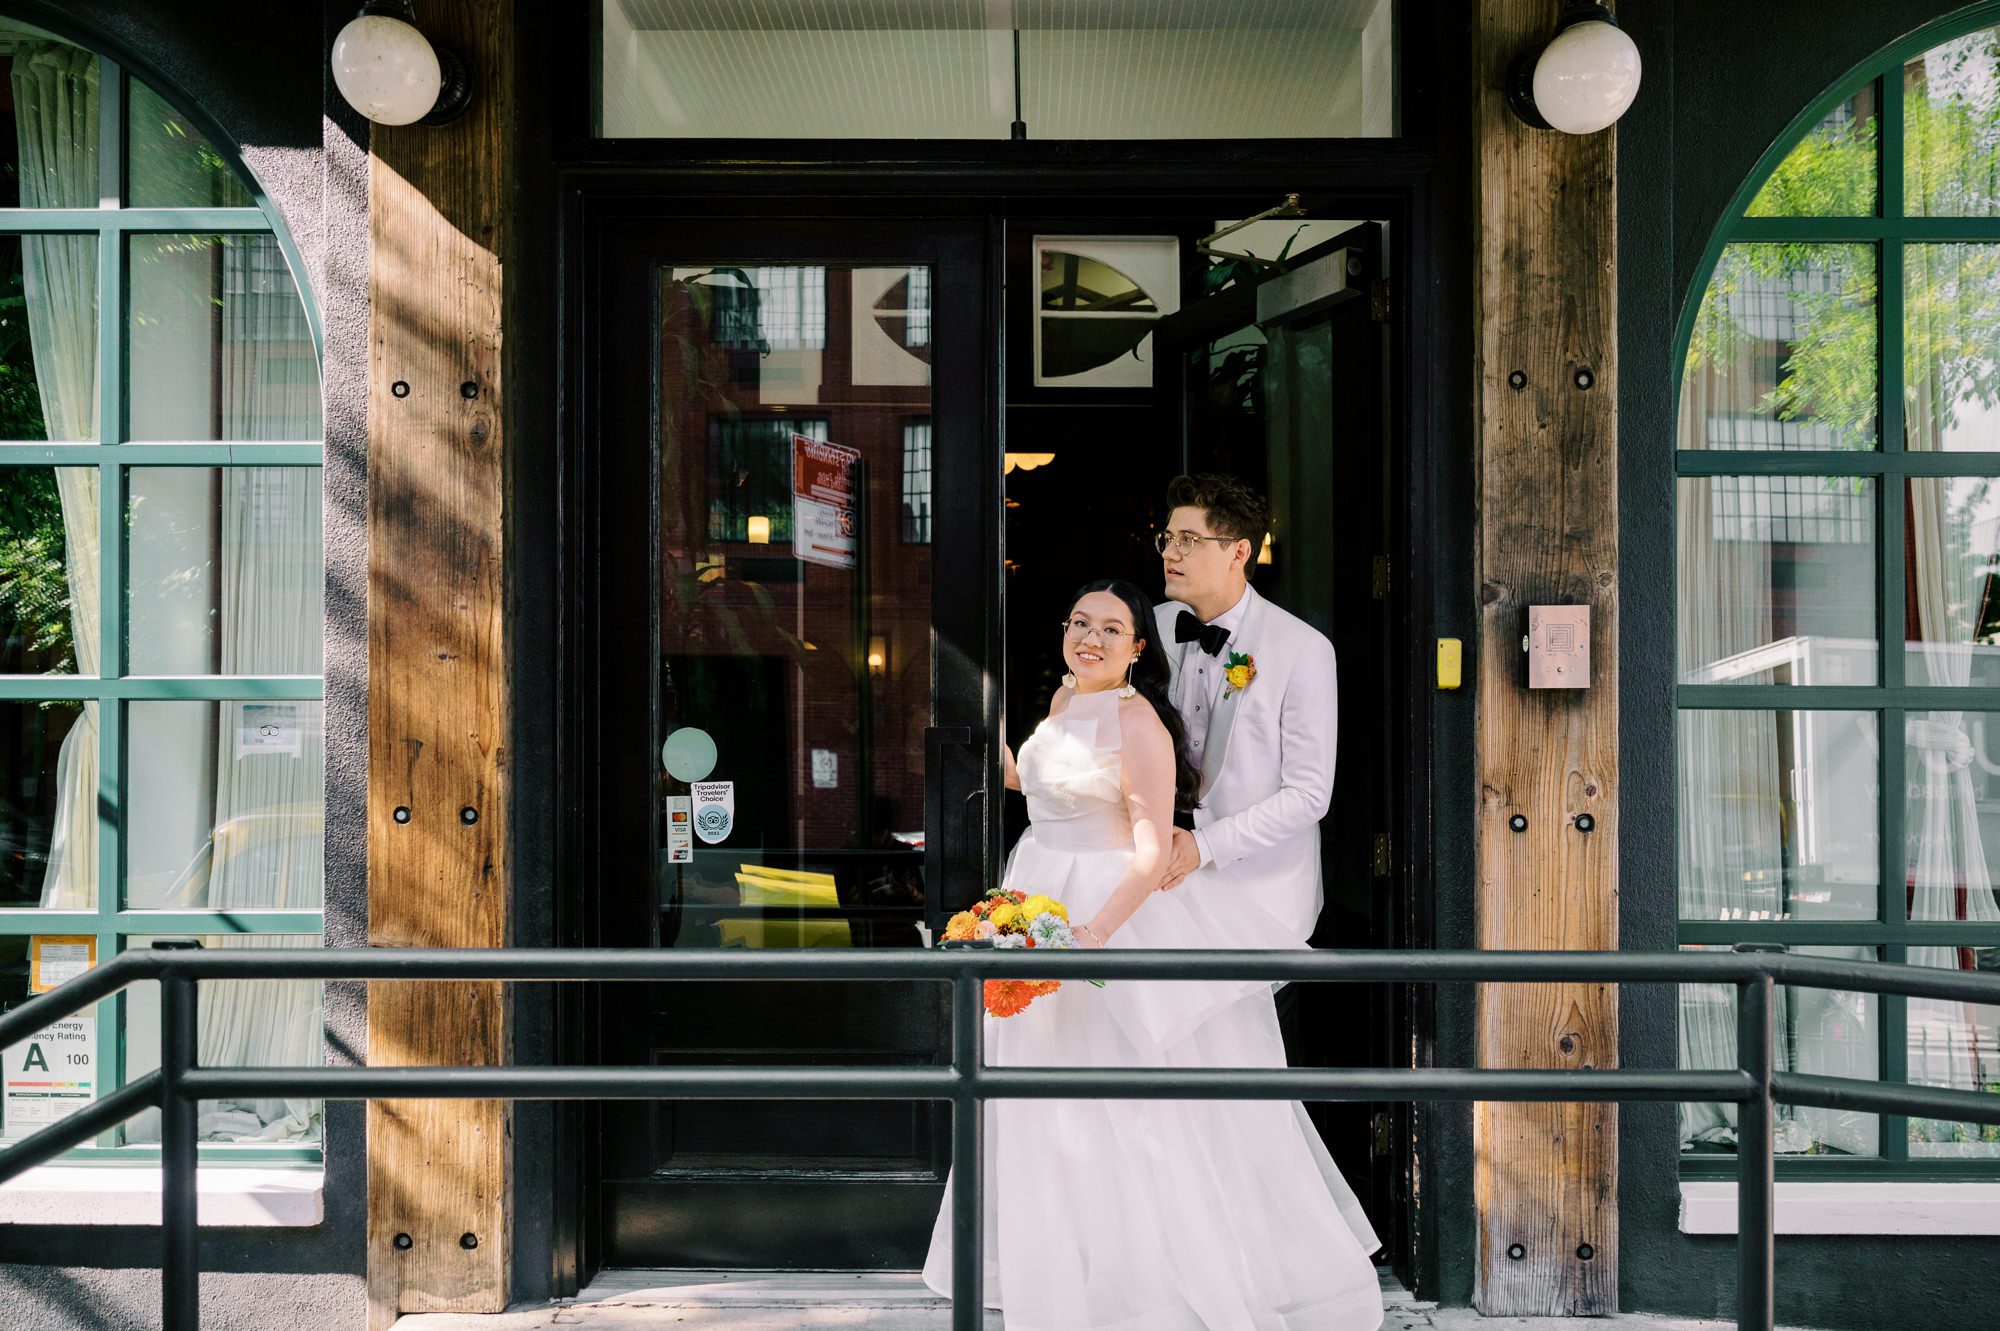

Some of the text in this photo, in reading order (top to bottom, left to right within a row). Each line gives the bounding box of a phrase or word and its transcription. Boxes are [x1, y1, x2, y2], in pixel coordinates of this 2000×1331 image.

[57, 1032, 86, 1042] Rating
[22, 1042, 89, 1072] A 100
